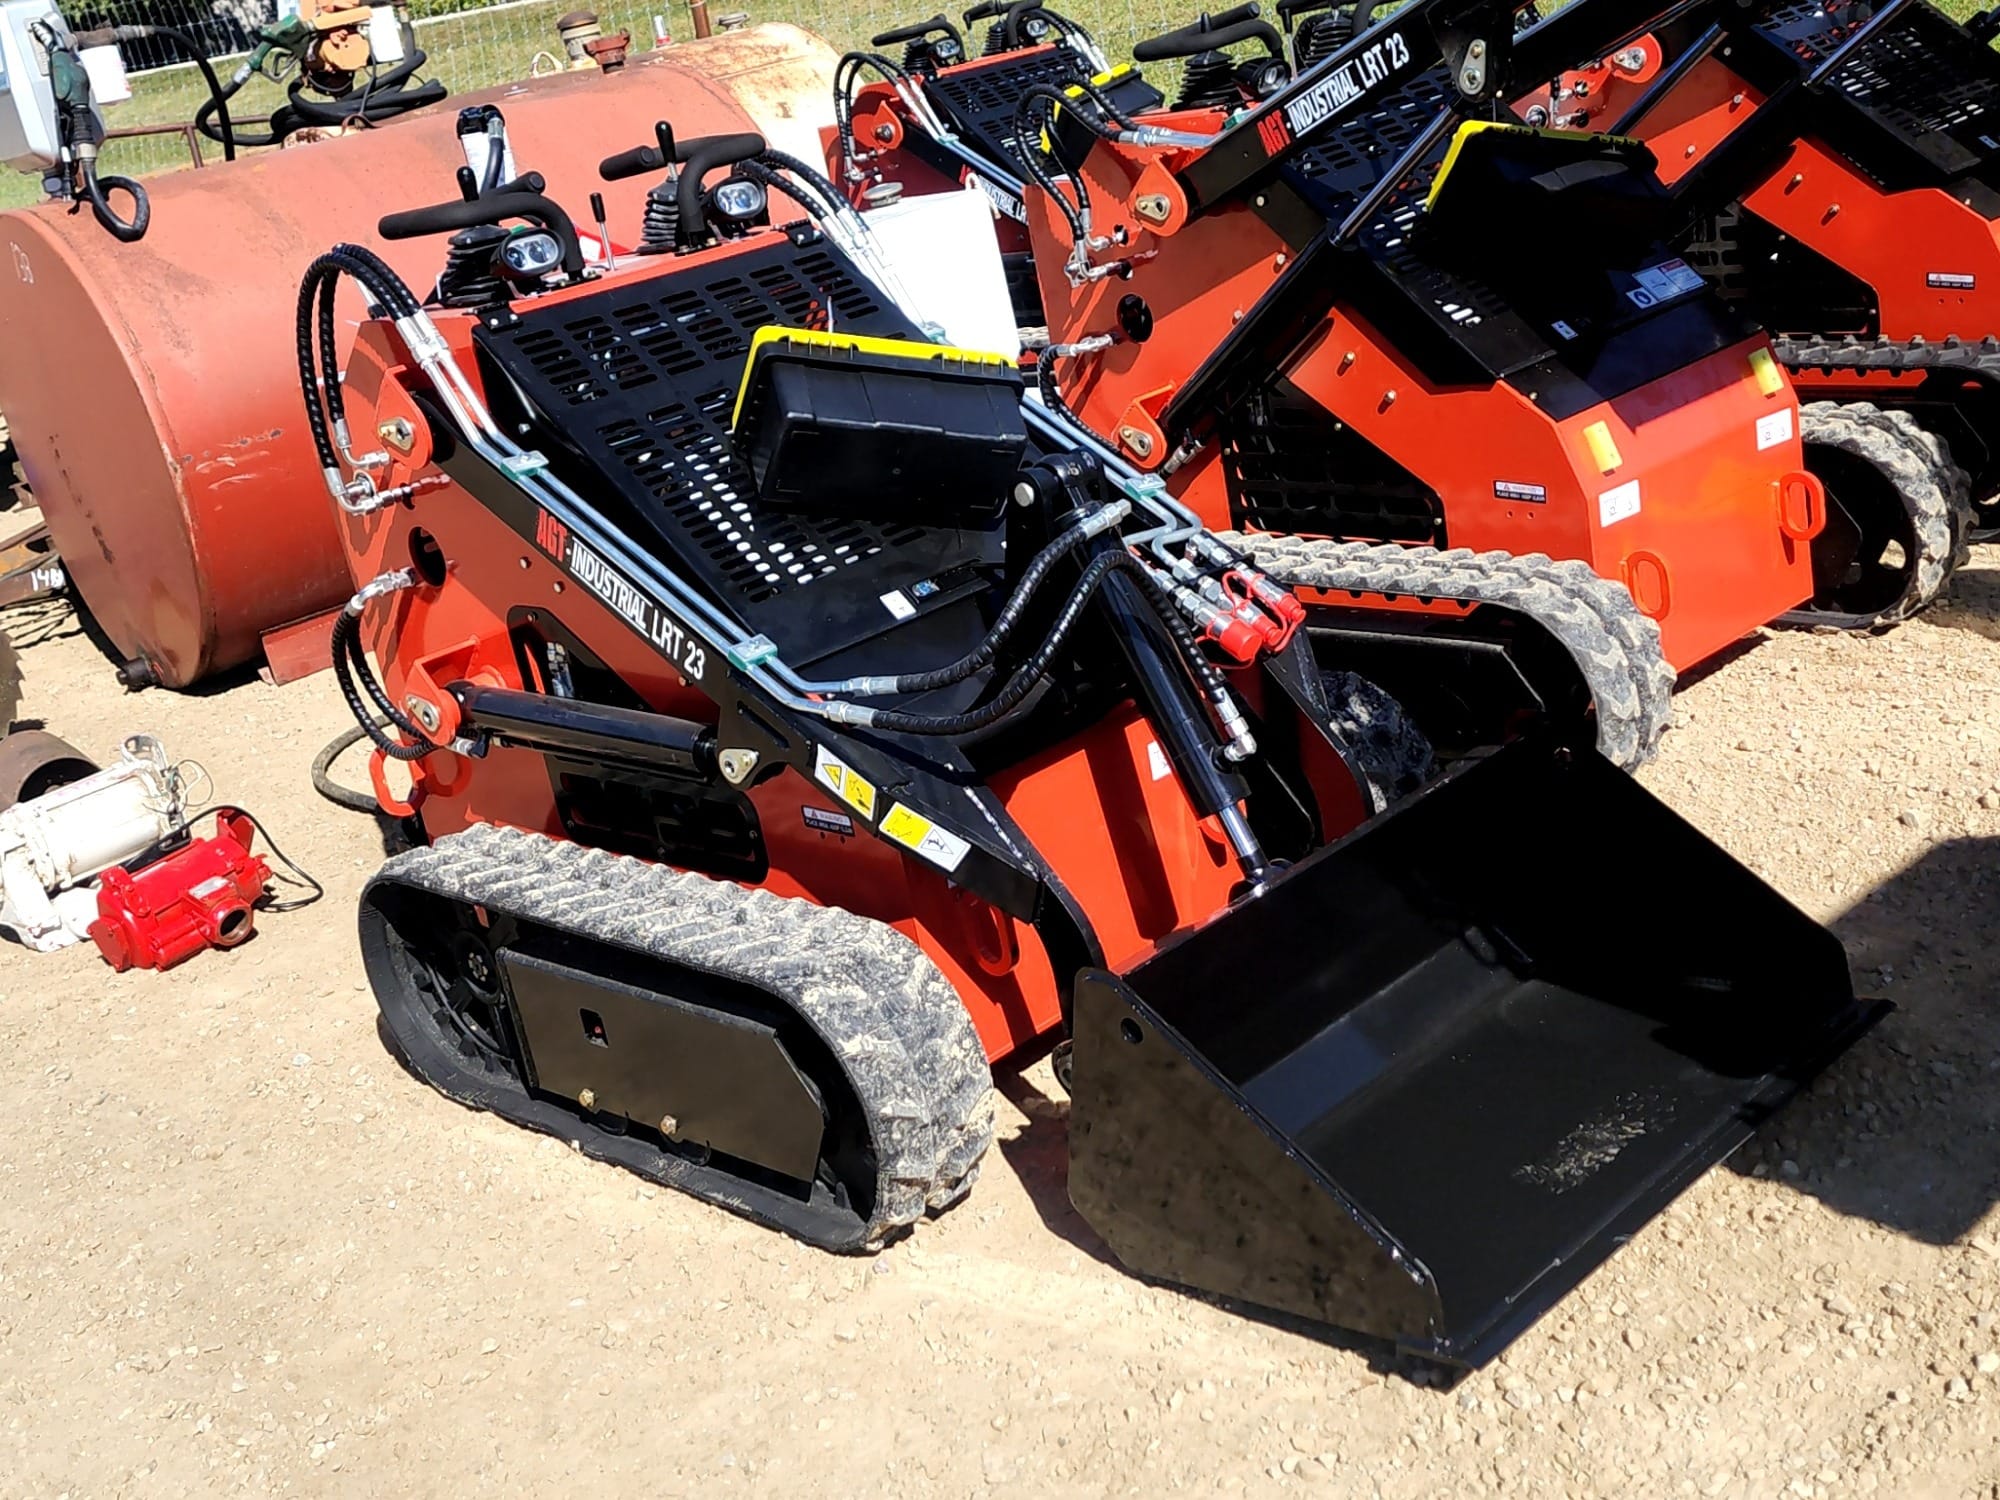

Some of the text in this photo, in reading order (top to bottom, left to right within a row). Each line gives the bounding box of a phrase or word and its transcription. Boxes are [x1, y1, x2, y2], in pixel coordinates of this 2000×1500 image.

[1257, 32, 1410, 157] AGT INDUSTRIAL LRT 23
[536, 507, 706, 680] AGT INDUSTRIAL LRT 23
